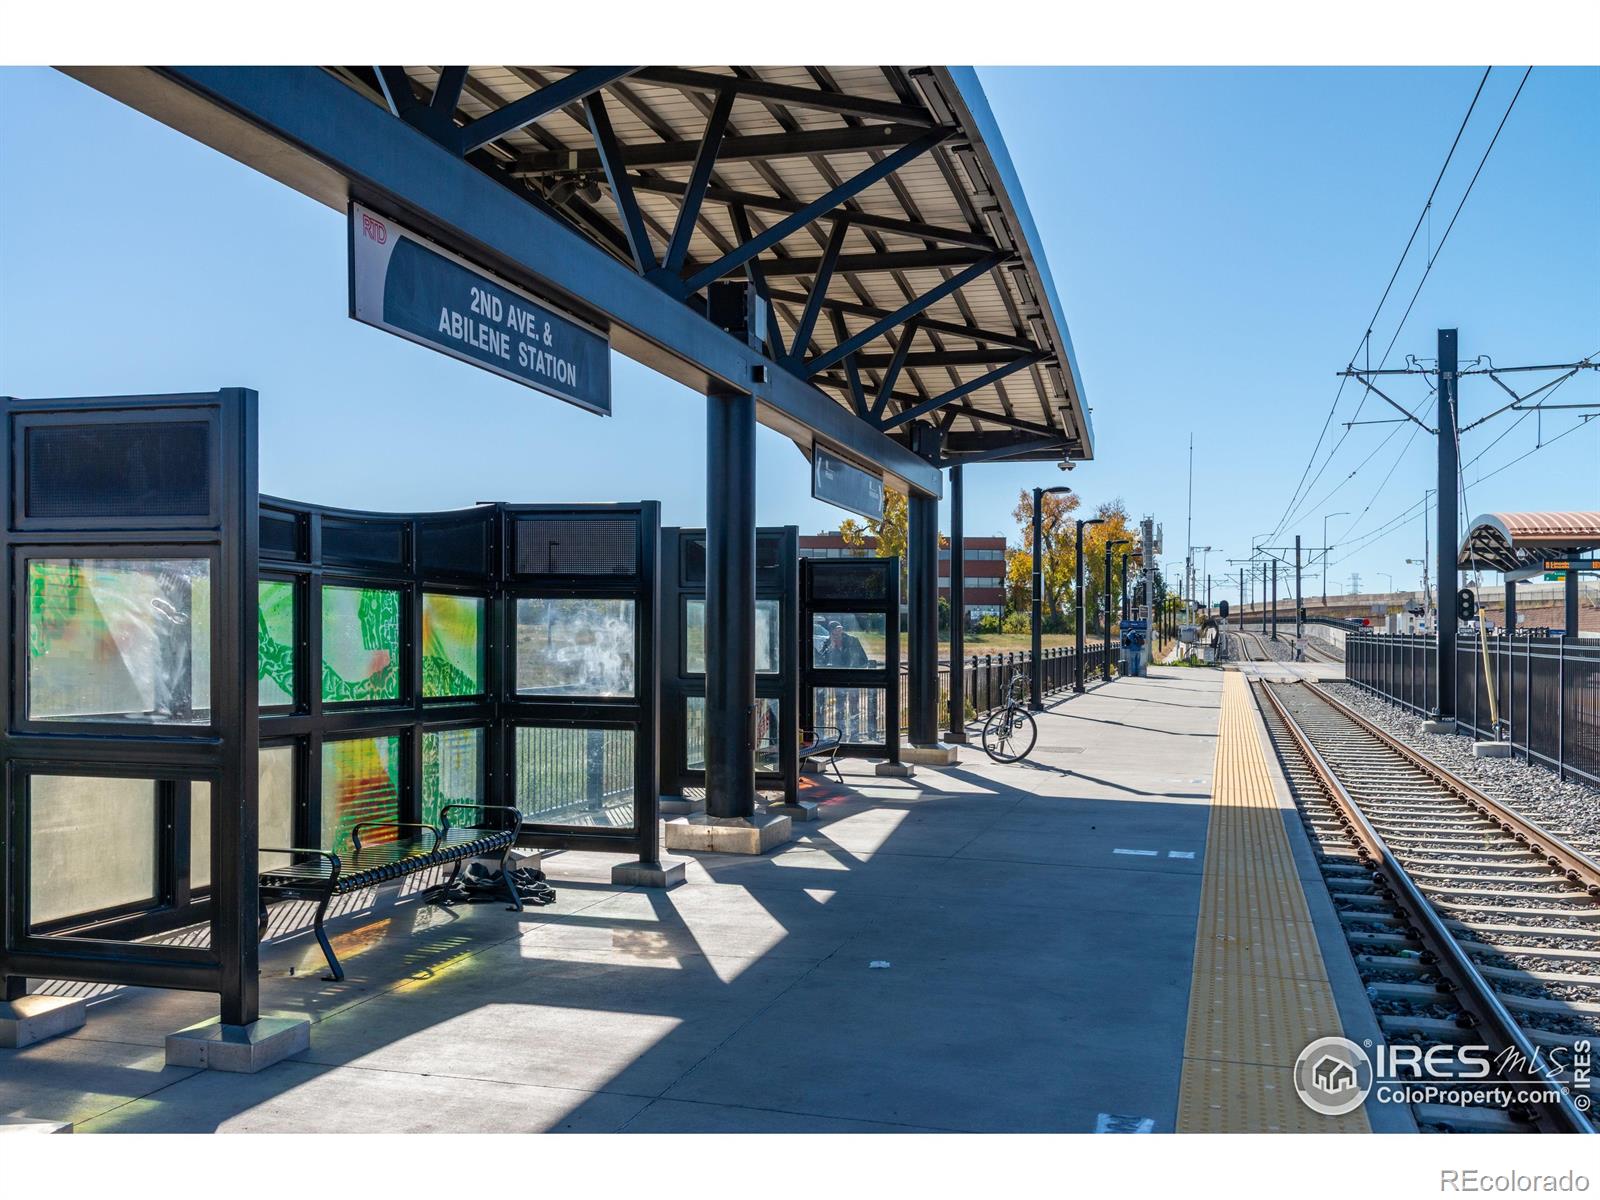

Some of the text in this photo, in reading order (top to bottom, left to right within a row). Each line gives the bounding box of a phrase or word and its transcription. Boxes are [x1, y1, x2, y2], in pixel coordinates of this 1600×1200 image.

[362, 213, 387, 244] RTD
[438, 306, 576, 387] ABILENE STATION
[470, 287, 552, 347] 2ND AVE. &
